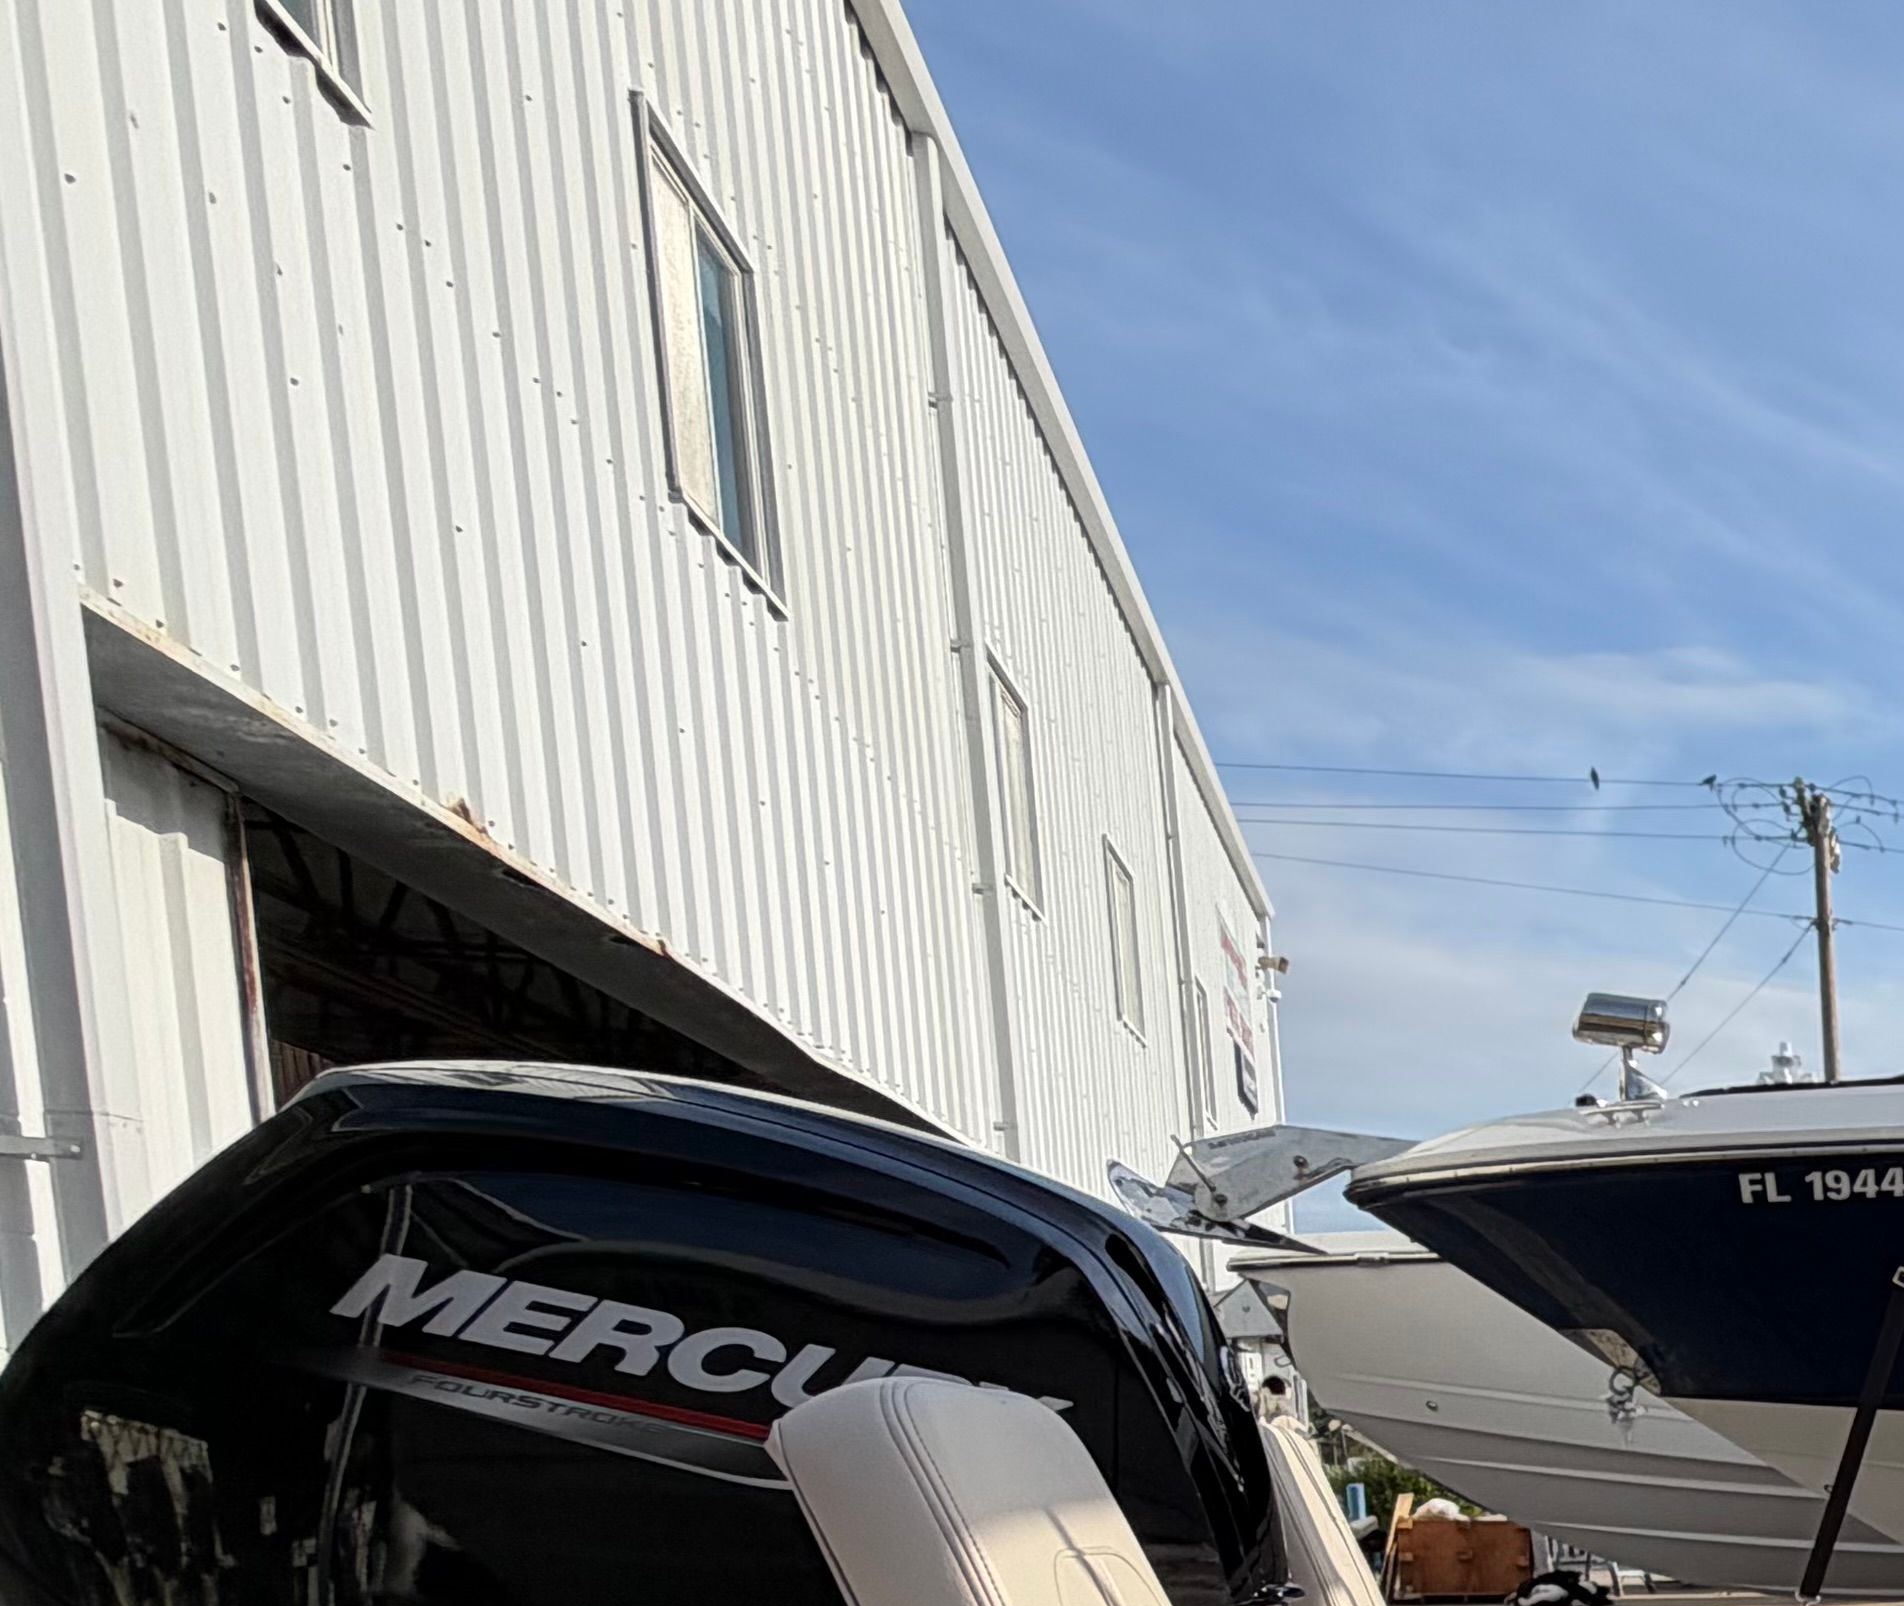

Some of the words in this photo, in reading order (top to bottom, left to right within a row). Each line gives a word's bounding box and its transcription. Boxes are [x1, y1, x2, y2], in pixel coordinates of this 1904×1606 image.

[1738, 1172, 1792, 1204] FL
[329, 1252, 1076, 1410] MERCU
[406, 1371, 673, 1433] FOURSTROKE
